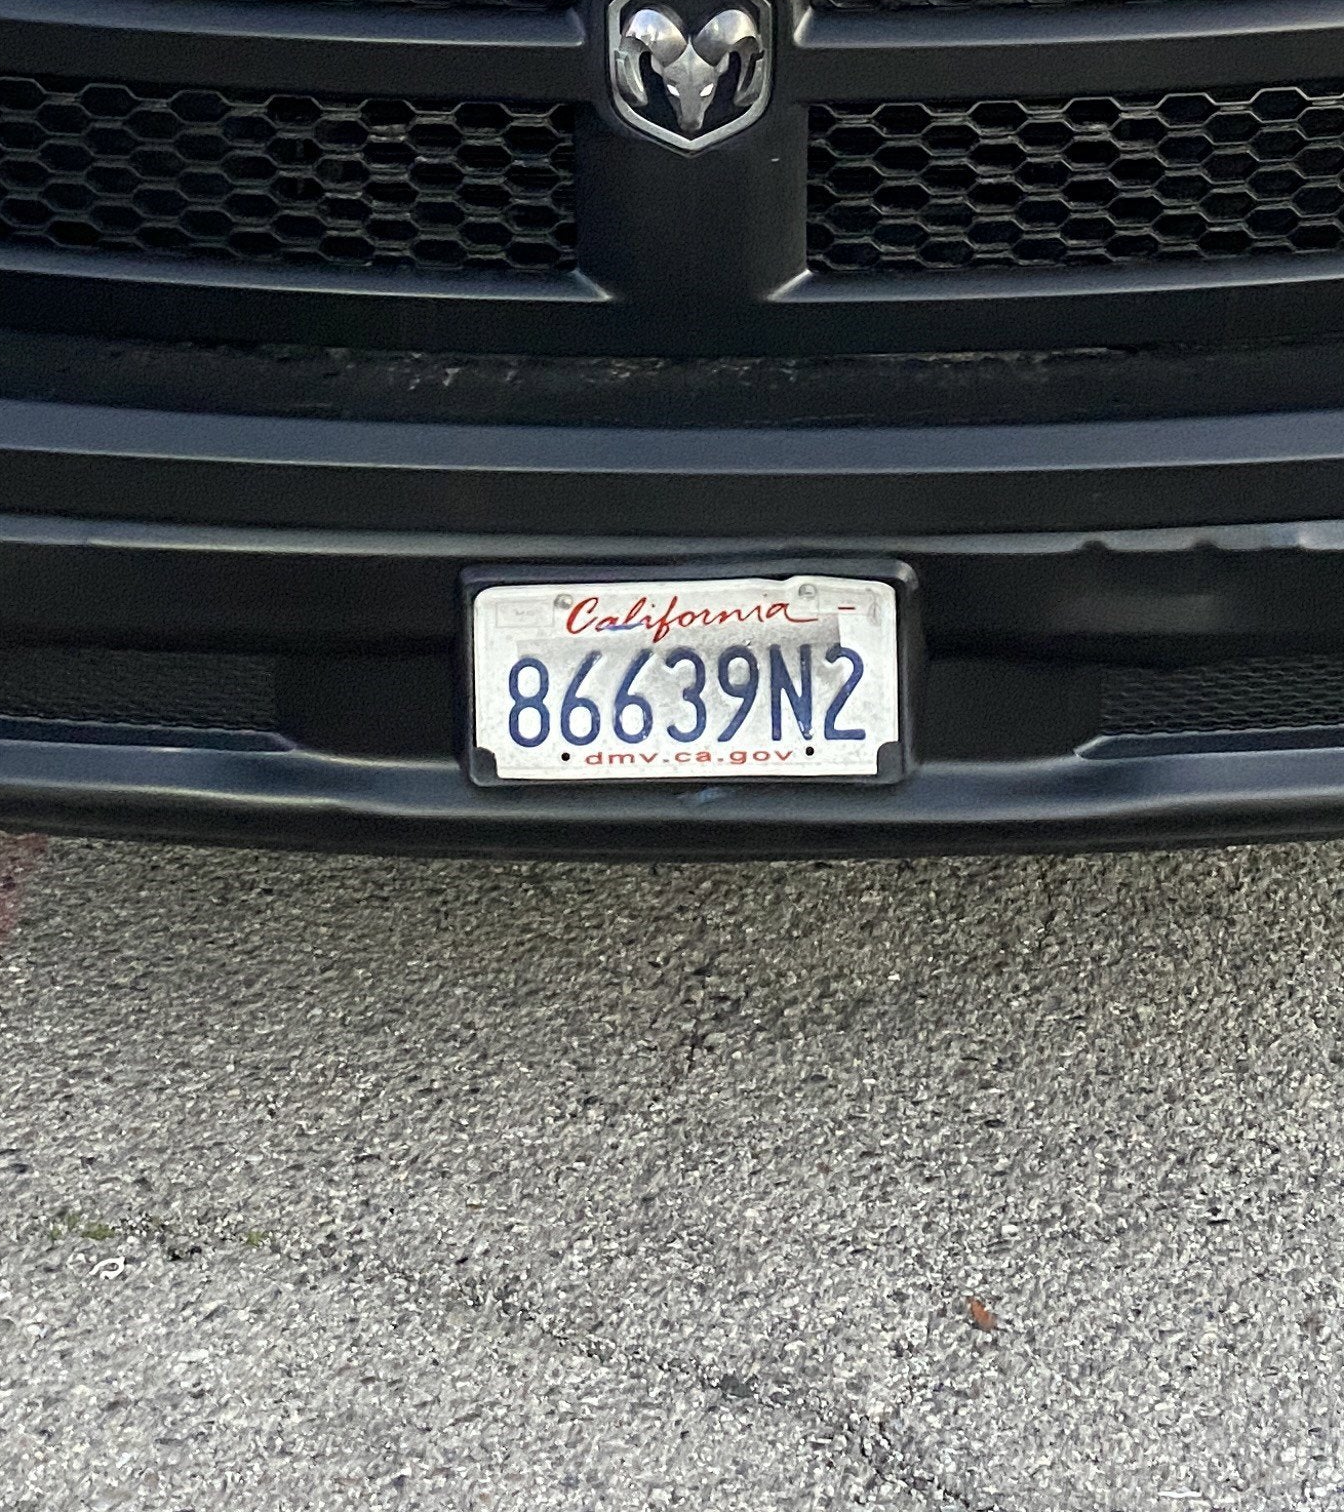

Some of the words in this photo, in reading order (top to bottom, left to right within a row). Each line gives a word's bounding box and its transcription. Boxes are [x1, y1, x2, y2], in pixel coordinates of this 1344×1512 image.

[565, 595, 818, 643] California
[508, 643, 866, 748] 86639N2
[584, 748, 794, 767] dmv.ca.gov
